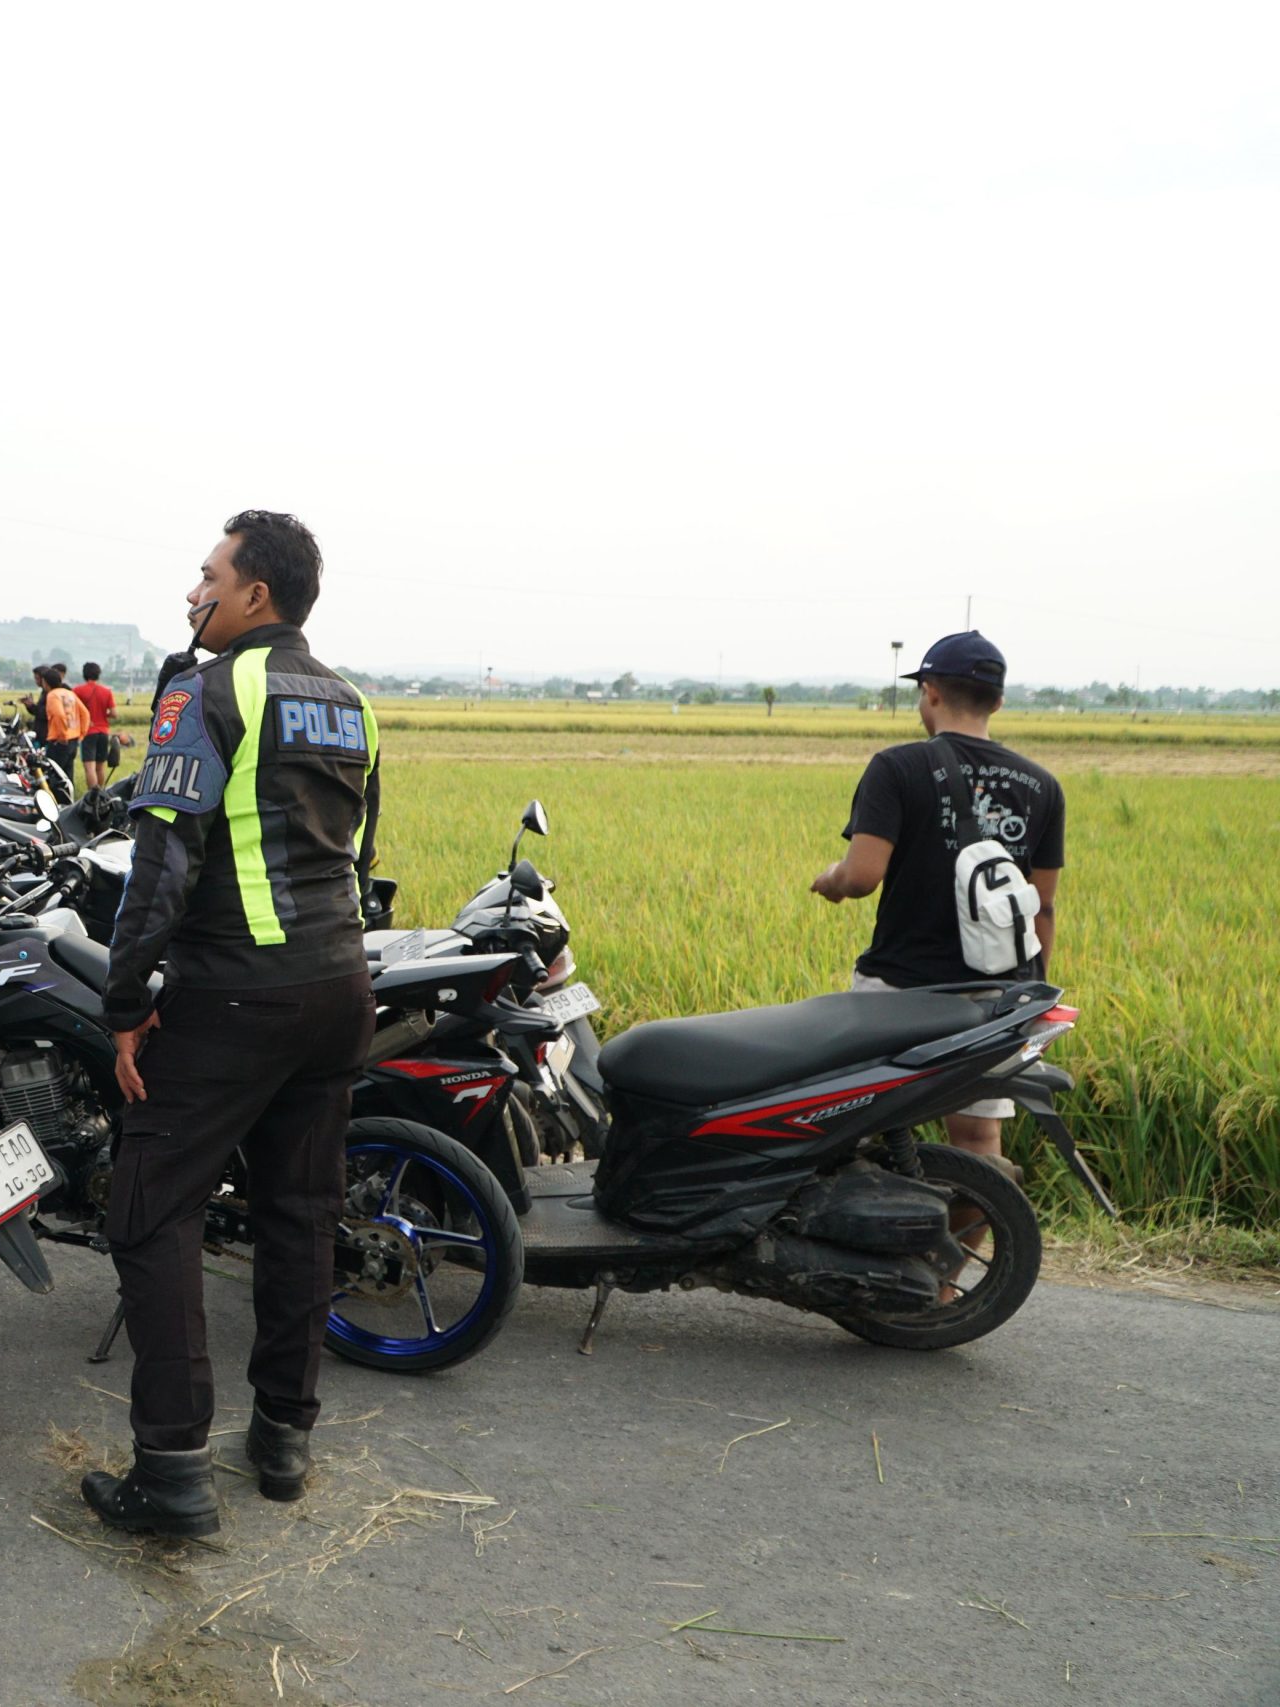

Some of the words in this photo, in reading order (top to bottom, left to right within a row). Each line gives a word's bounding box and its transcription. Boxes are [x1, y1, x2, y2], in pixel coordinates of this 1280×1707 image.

[280, 701, 366, 751] POLISI
[979, 765, 1041, 794] APPAREL
[440, 1070, 492, 1086] HONDA
